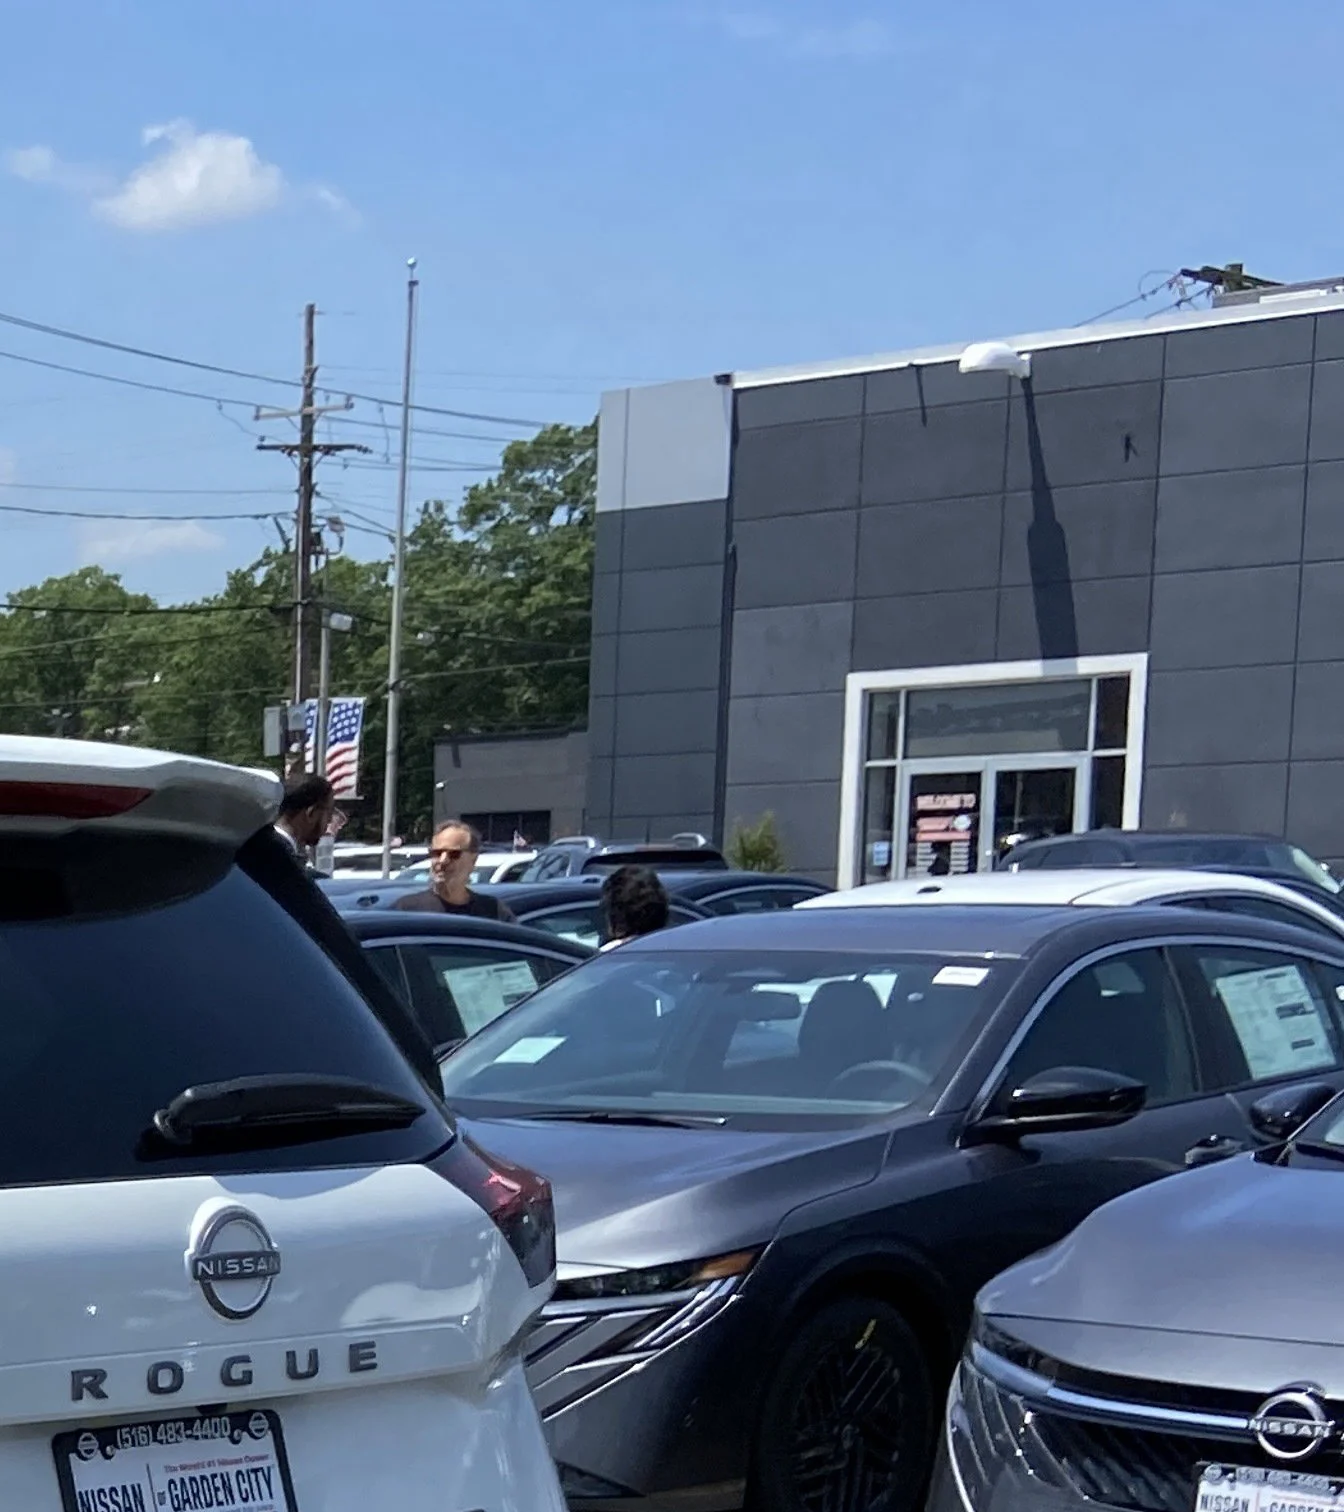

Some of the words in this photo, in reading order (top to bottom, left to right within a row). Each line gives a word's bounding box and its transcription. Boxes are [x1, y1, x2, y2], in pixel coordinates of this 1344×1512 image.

[197, 1257, 279, 1277] NISSAN
[70, 1340, 378, 1402] ROGUE
[116, 1422, 153, 1449] (516)
[156, 1416, 231, 1446] 483-4400
[1248, 1418, 1331, 1438] NISSAN
[167, 1471, 236, 1512] GARDEN
[235, 1465, 275, 1504] CITY
